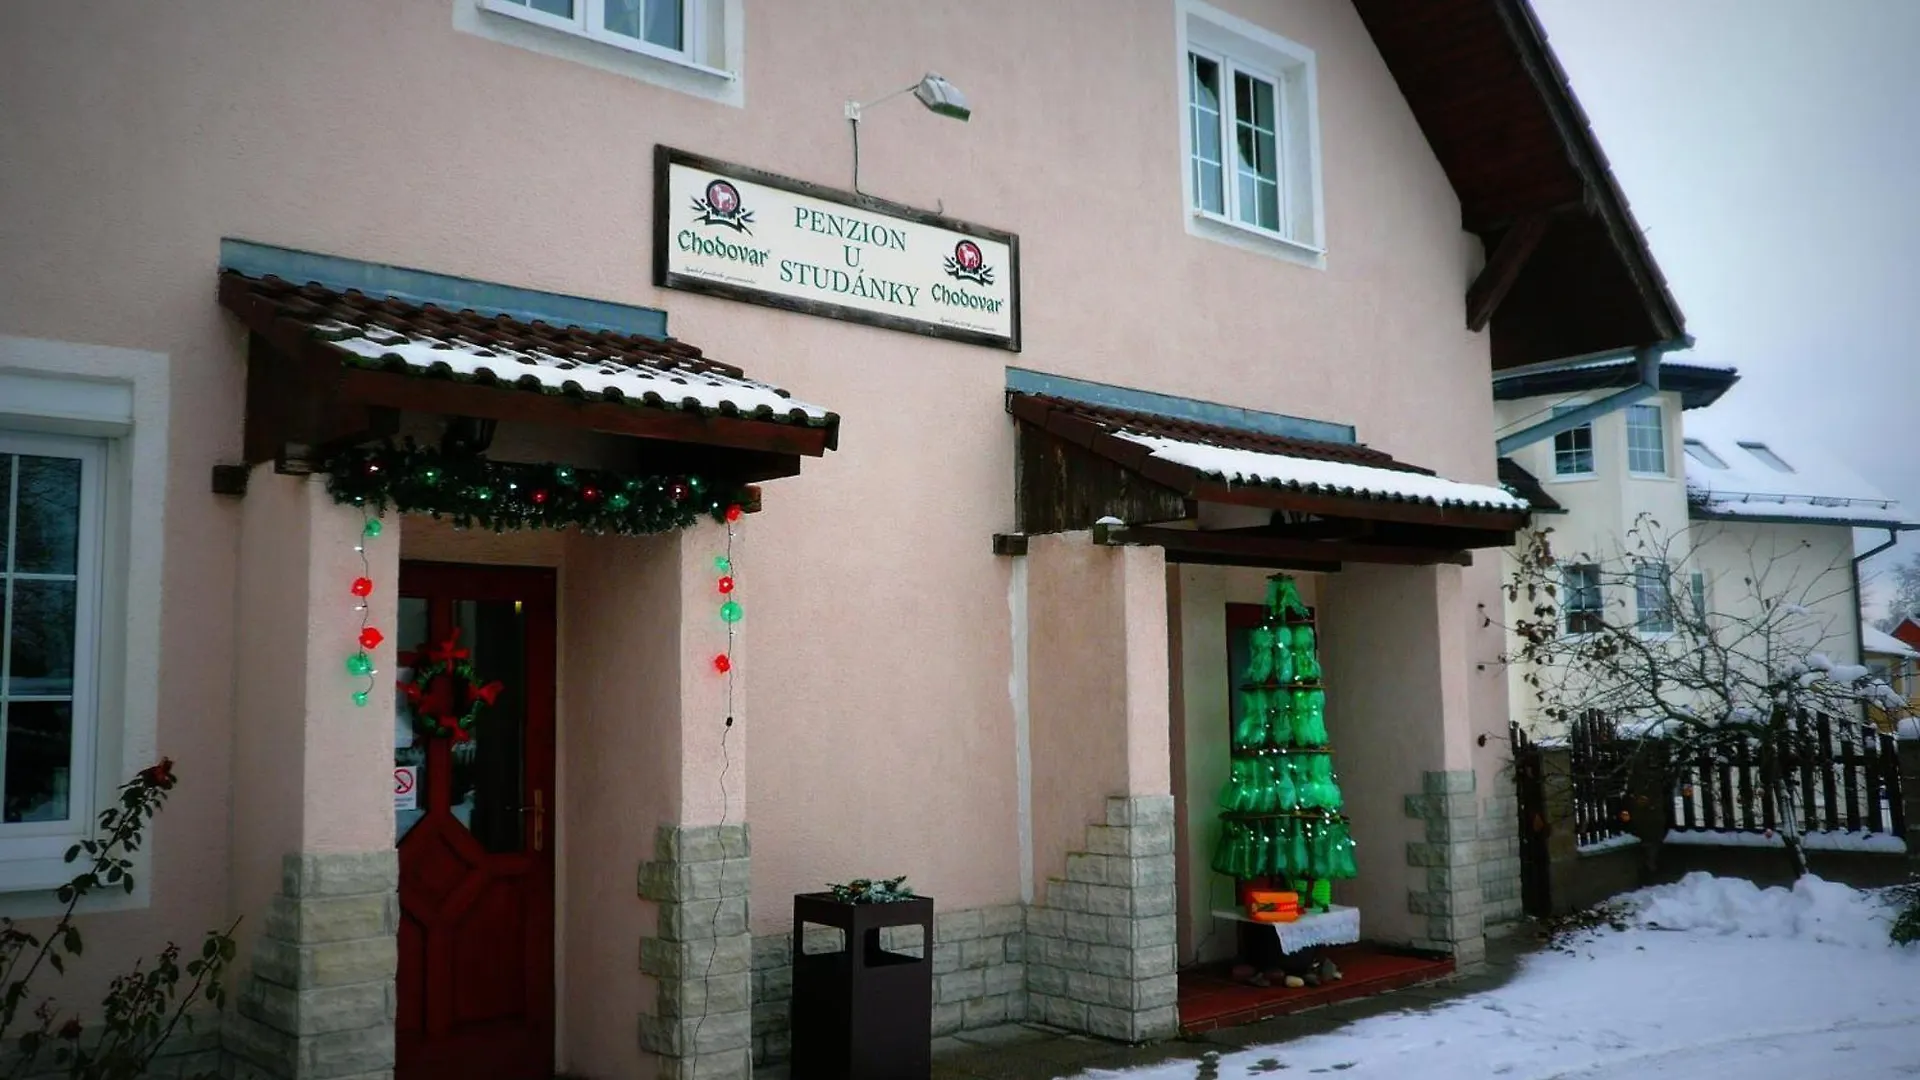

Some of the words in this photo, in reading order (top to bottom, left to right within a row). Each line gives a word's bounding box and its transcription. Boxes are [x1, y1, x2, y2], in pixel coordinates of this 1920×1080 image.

[677, 229, 769, 267] Chodovar
[794, 206, 906, 252] PENZION
[843, 244, 861, 268] U
[779, 259, 920, 307] STUDÁNKY
[931, 283, 1003, 314] Chodovar
